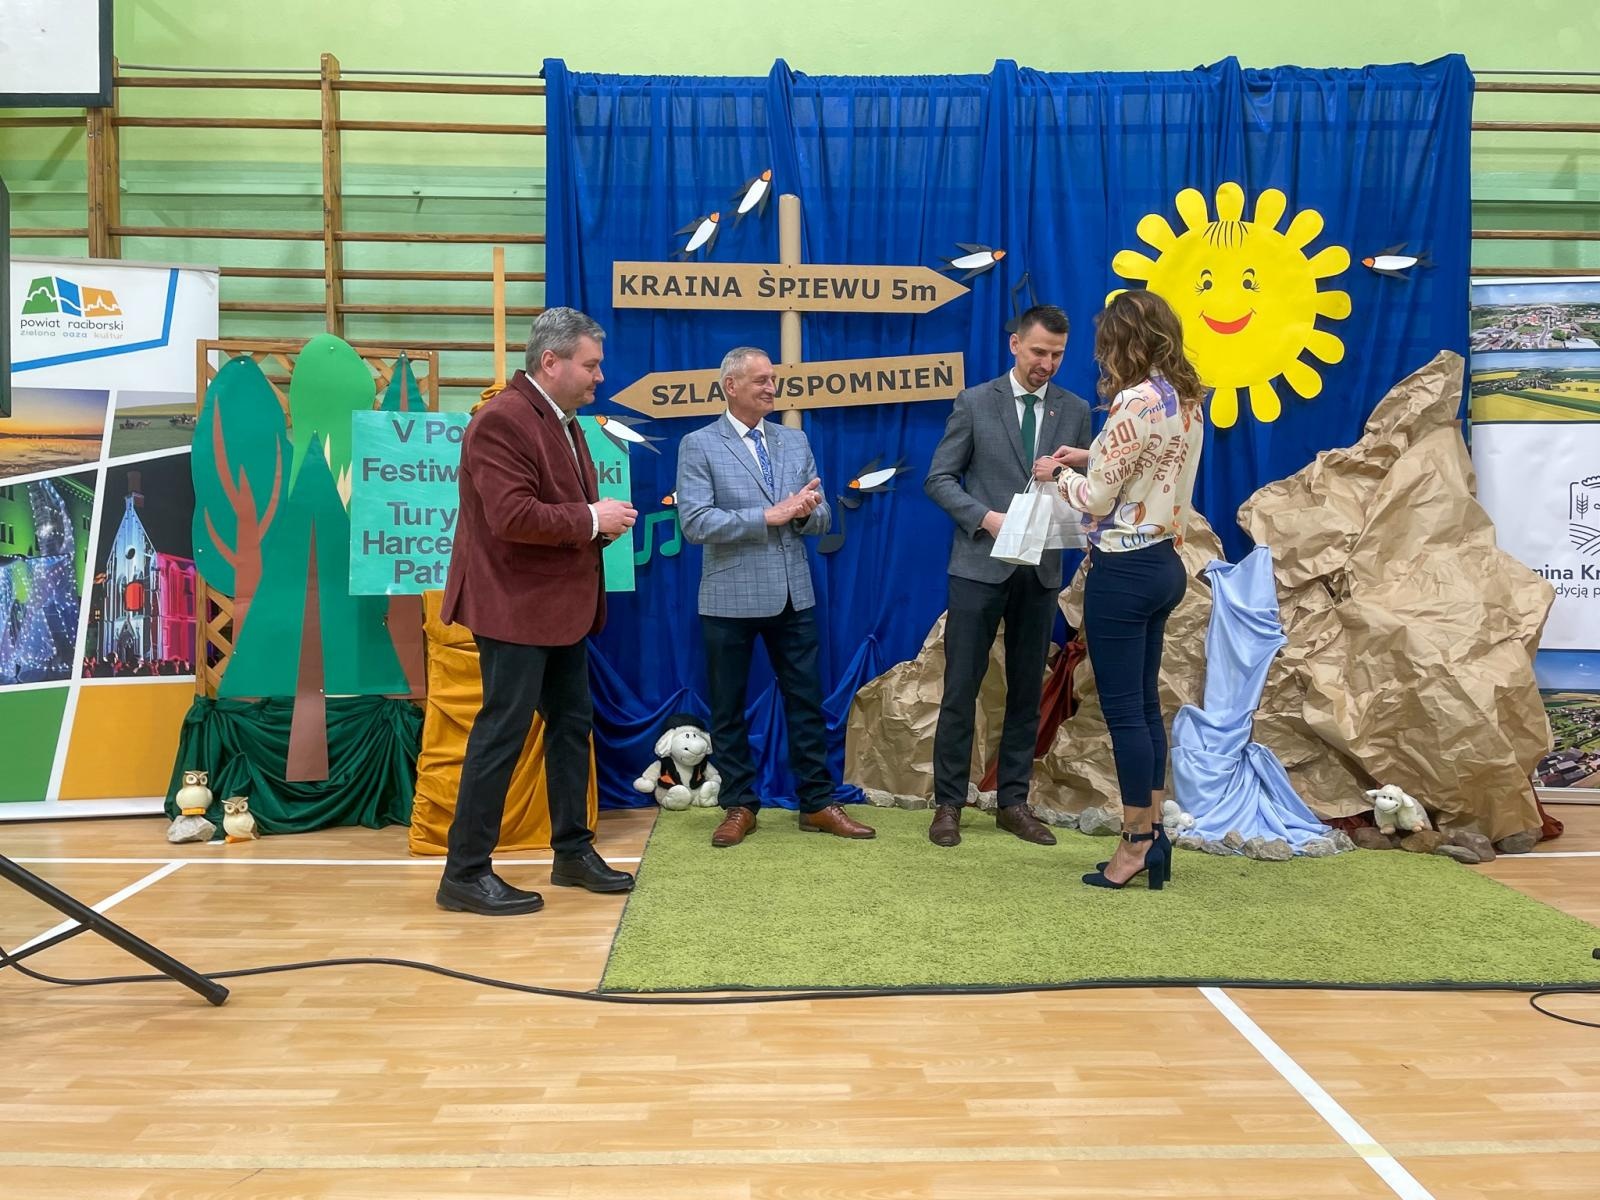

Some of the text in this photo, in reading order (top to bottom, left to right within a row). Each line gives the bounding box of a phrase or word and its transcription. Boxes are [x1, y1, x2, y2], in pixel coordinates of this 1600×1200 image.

[619, 274, 742, 298] KRAINA
[892, 279, 937, 302] 5m
[20, 317, 124, 331] powiat raciborski
[20, 329, 56, 337] zielona
[94, 331, 124, 339] kultur
[652, 381, 726, 406] SZLA
[392, 420, 464, 443] V Po
[362, 457, 622, 484] Festiw ki
[387, 502, 457, 532] Tury
[363, 530, 452, 555] Harce
[394, 559, 449, 584] Pat
[1555, 583, 1588, 598] dycją
